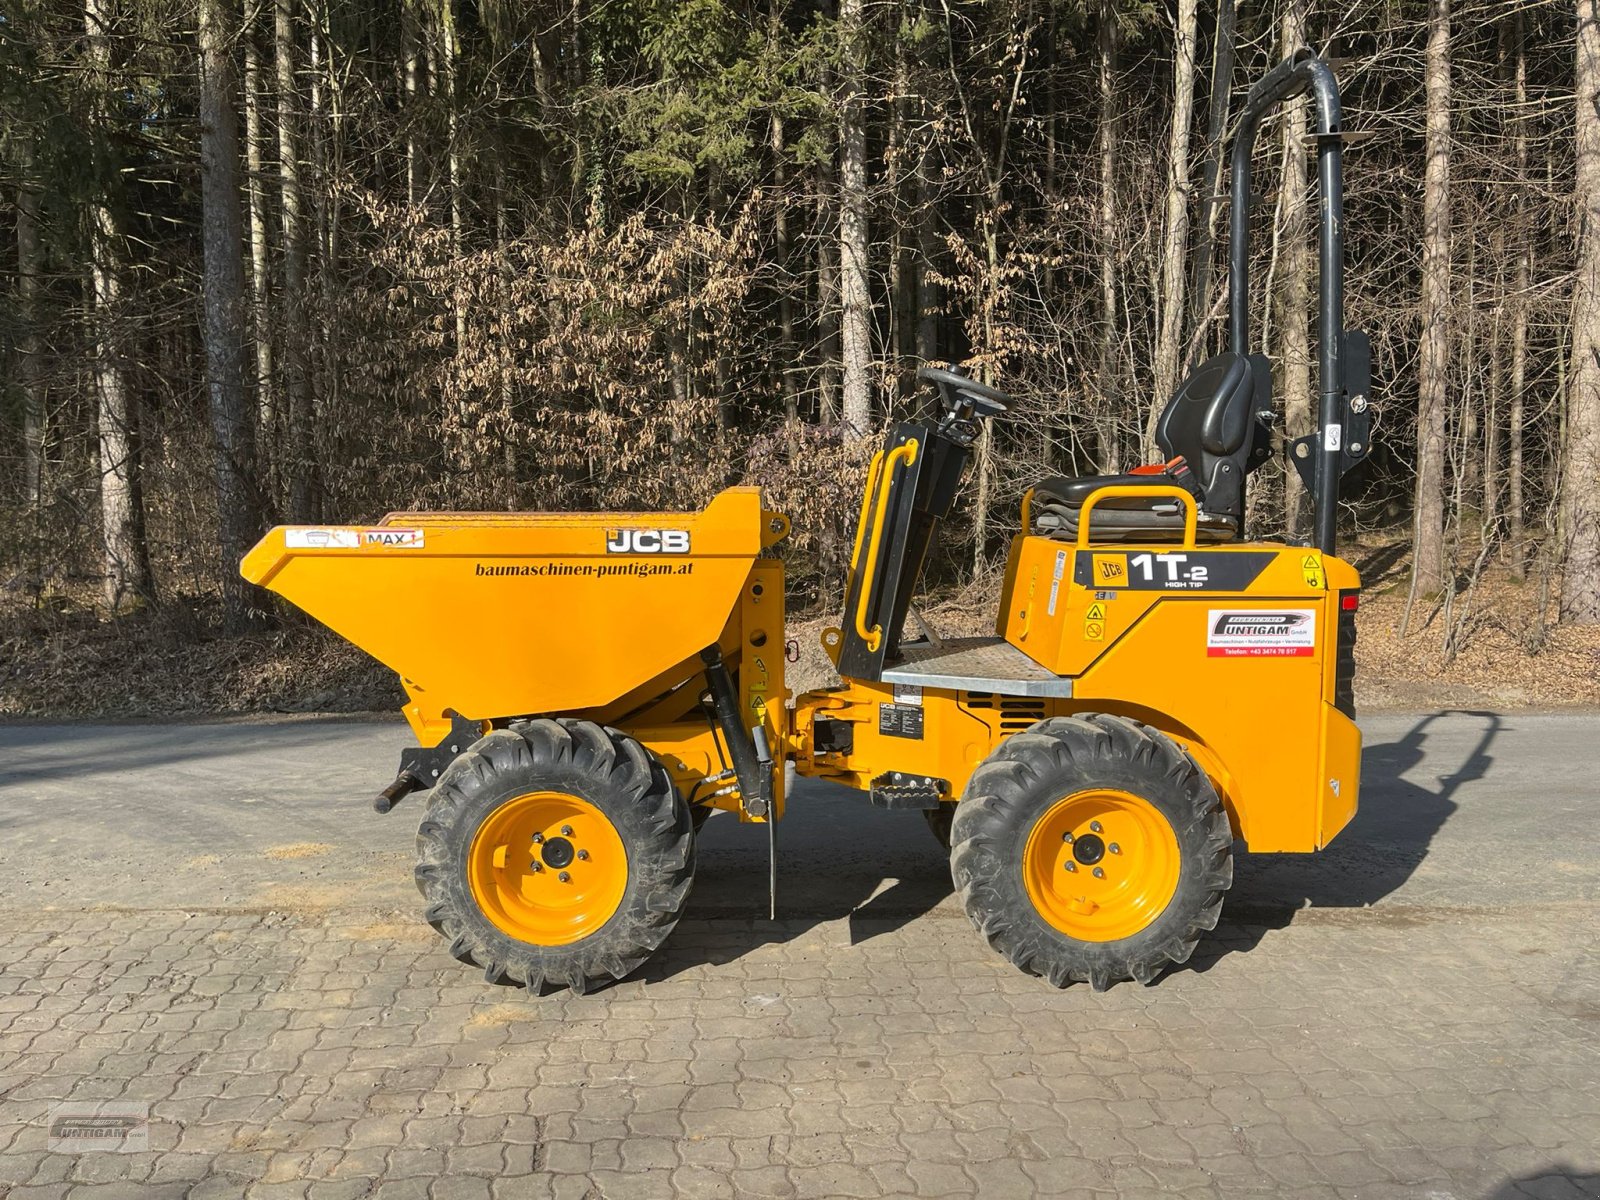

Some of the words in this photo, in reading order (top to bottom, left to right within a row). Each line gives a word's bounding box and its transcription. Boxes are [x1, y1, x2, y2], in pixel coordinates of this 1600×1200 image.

[368, 534, 405, 546] MAX
[608, 530, 689, 552] JCB
[475, 562, 693, 577] baumaschinen-puntigam.at
[1101, 562, 1122, 578] JCB
